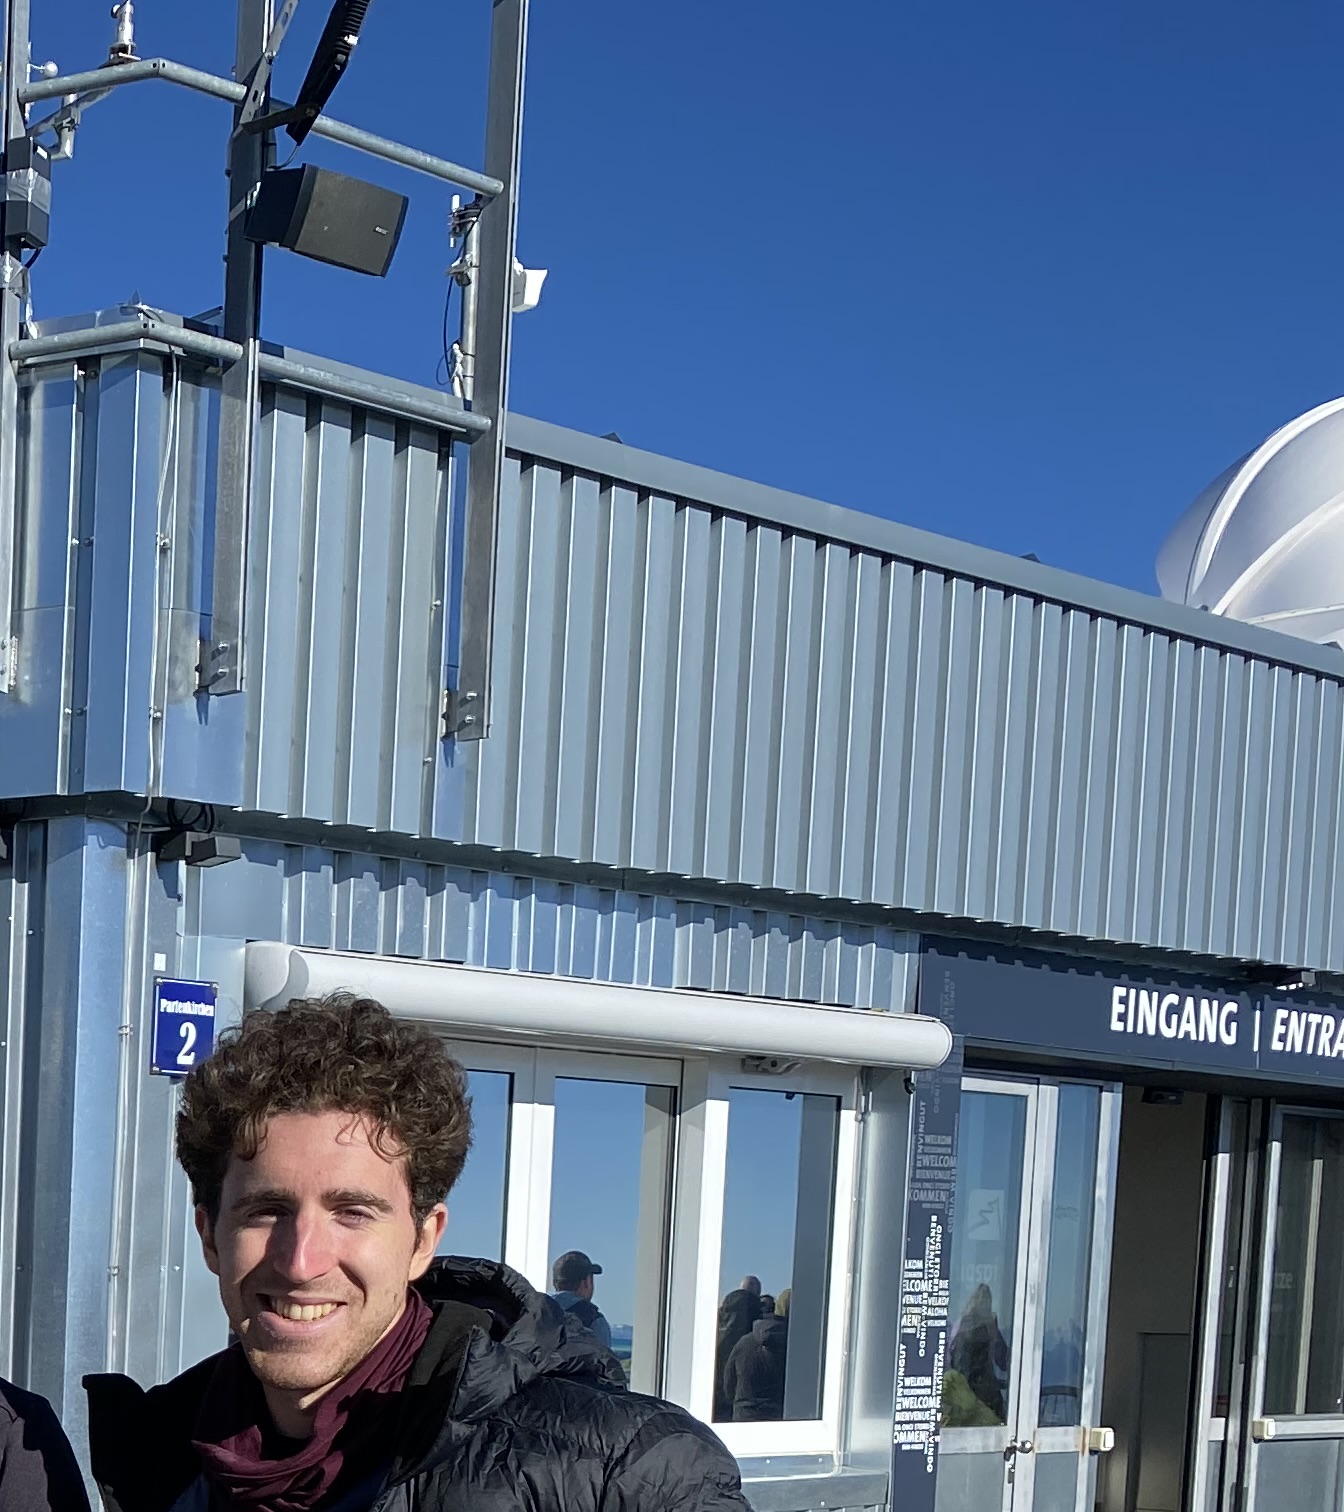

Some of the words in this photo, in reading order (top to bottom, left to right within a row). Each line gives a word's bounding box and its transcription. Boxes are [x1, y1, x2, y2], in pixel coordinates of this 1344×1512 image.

[1110, 985, 1239, 1046] EINGANG
[176, 1021, 197, 1065] 2
[902, 1396, 941, 1409] WELCOME
